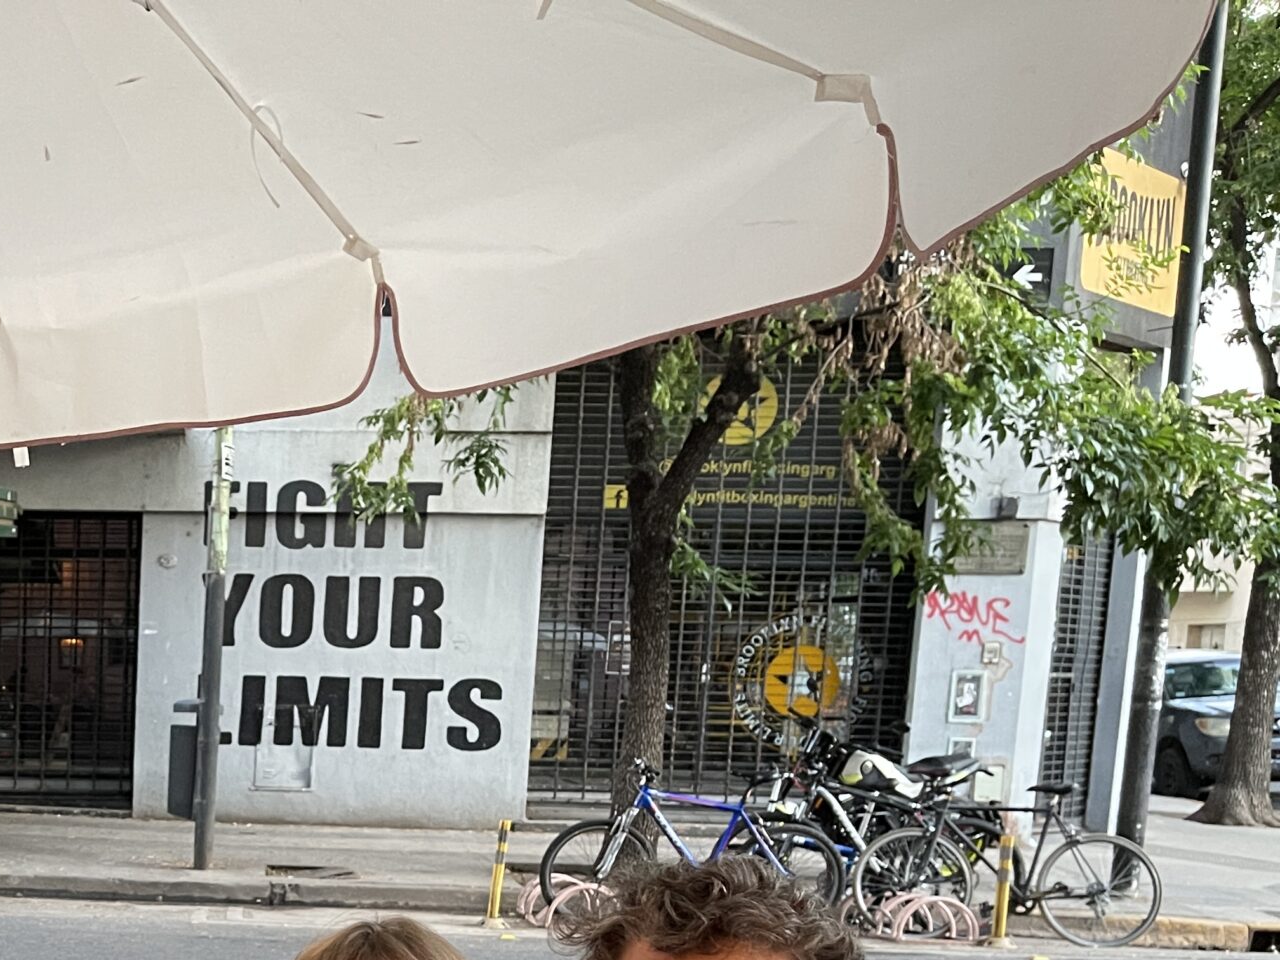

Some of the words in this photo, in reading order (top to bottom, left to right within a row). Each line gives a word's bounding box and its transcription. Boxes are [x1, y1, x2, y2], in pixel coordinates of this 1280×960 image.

[1095, 166, 1176, 272] ROOKLYN
[202, 573, 444, 648] YOUR
[197, 675, 503, 751] IMITS
